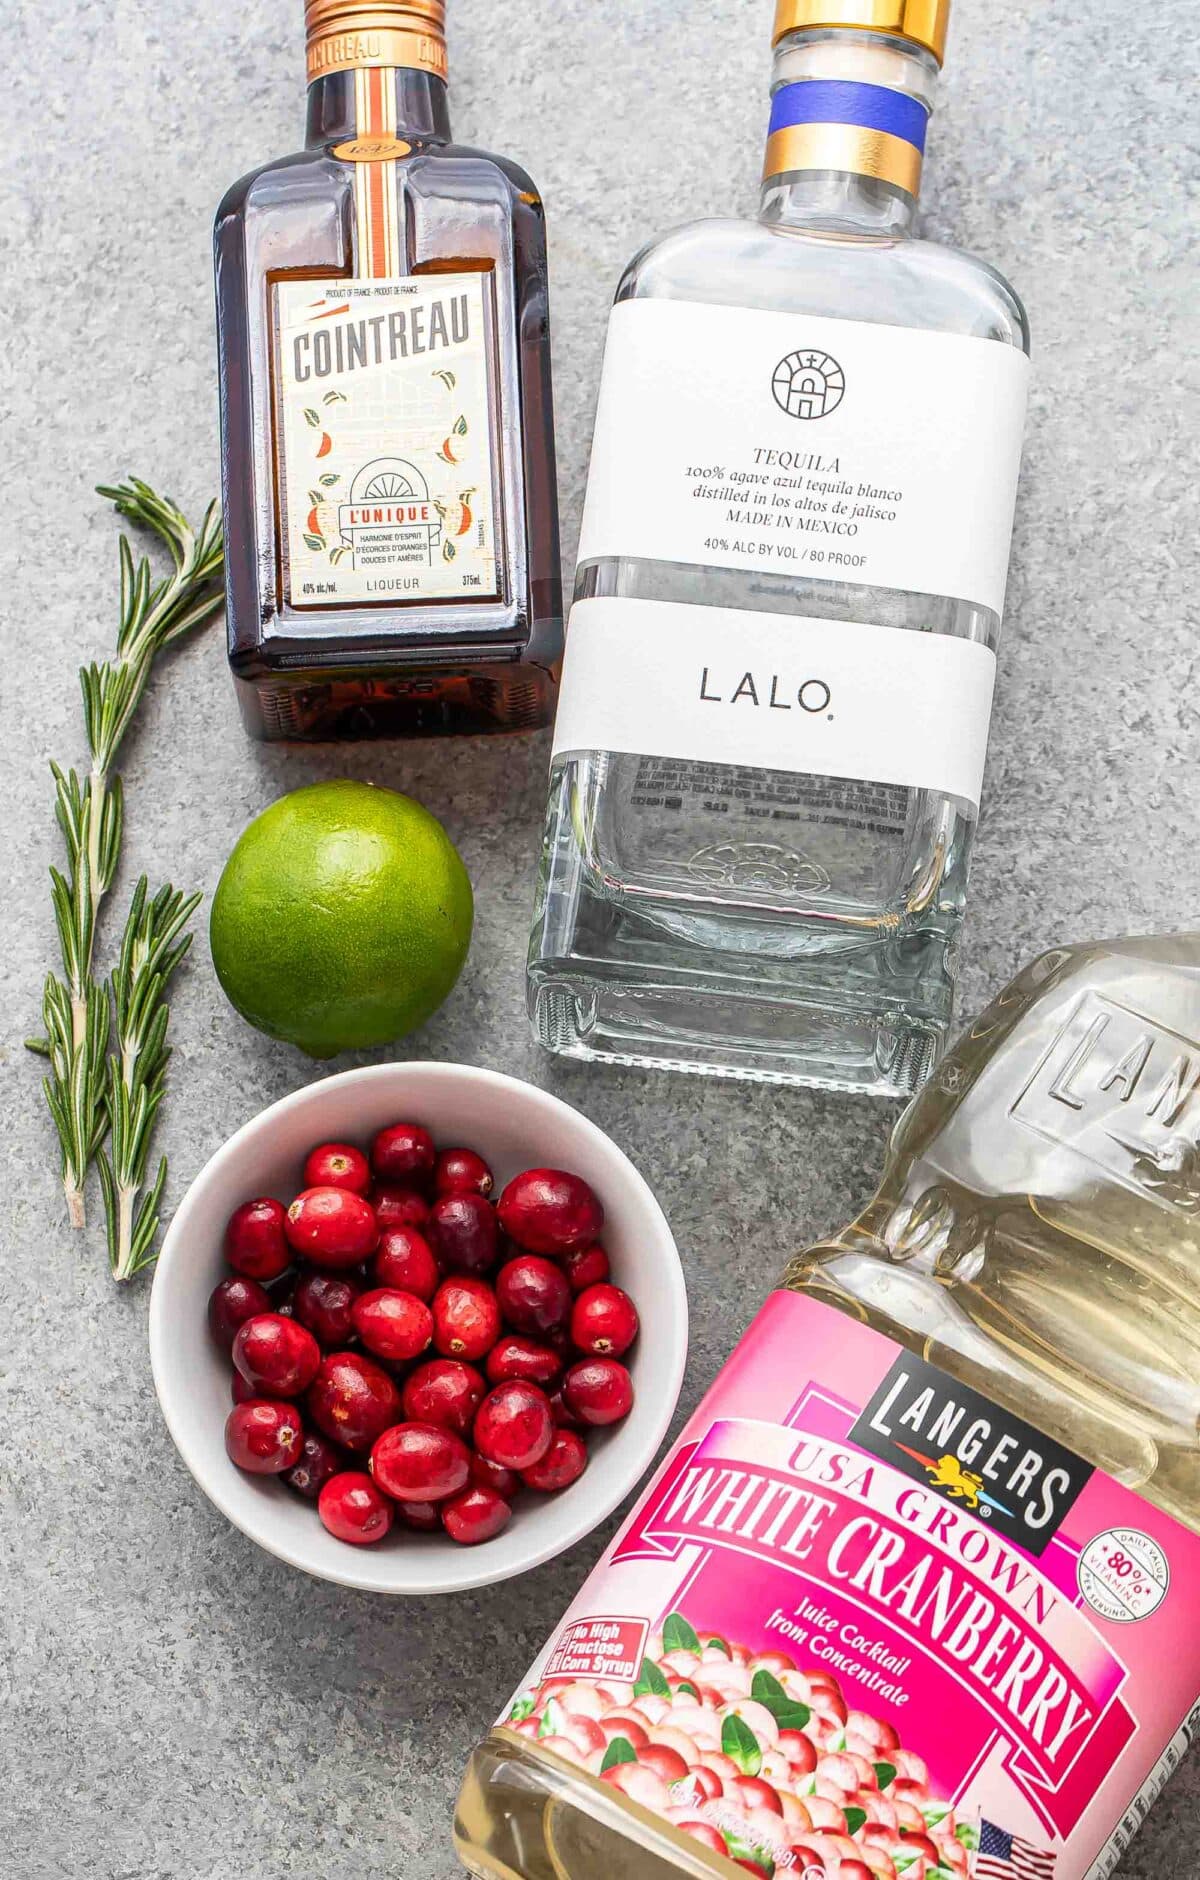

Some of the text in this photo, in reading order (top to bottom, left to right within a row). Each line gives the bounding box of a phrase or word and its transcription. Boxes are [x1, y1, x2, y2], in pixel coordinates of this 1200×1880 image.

[326, 285, 418, 298] PRODUCT OF FRANCE PRODUIT DE FRANCE
[293, 294, 469, 383] COINTREAU
[753, 448, 841, 474] TEQUILA
[685, 466, 903, 502] 100% agave azul tequila blanco
[350, 506, 429, 524] L'UNIQUE
[693, 485, 897, 521] distilled in los altos de jalisco
[360, 533, 422, 542] HARMONIE D'ESPRIT
[726, 509, 858, 537] MADE IN MEXICO
[361, 555, 387, 564] DOUCES
[387, 555, 396, 563] ET
[392, 543, 428, 551] D'ORANGES
[704, 537, 729, 551] 40%
[732, 540, 756, 554] ALC
[758, 543, 774, 556] BY
[776, 545, 799, 559] VOL
[809, 550, 825, 563] 80
[828, 552, 868, 568] PROOF
[302, 583, 315, 594] 40%
[366, 578, 420, 591] LIQUEUR
[1048, 1012, 1200, 1128] LAN
[869, 1372, 1071, 1529] LANGERS
[788, 1440, 1059, 1626] USA GROWN
[1121, 1534, 1164, 1579] DAILY VALUE
[1107, 1551, 1147, 1594] 80%
[1083, 1572, 1127, 1617] PER SERVING
[664, 1466, 1093, 1764] WHITE CRANBERRY
[574, 1623, 620, 1641] No High
[794, 1596, 912, 1677] Juice Cocktail
[566, 1641, 624, 1656] Fructose
[764, 1608, 910, 1707] from Concentrate
[561, 1656, 635, 1678] Corn Syrup
